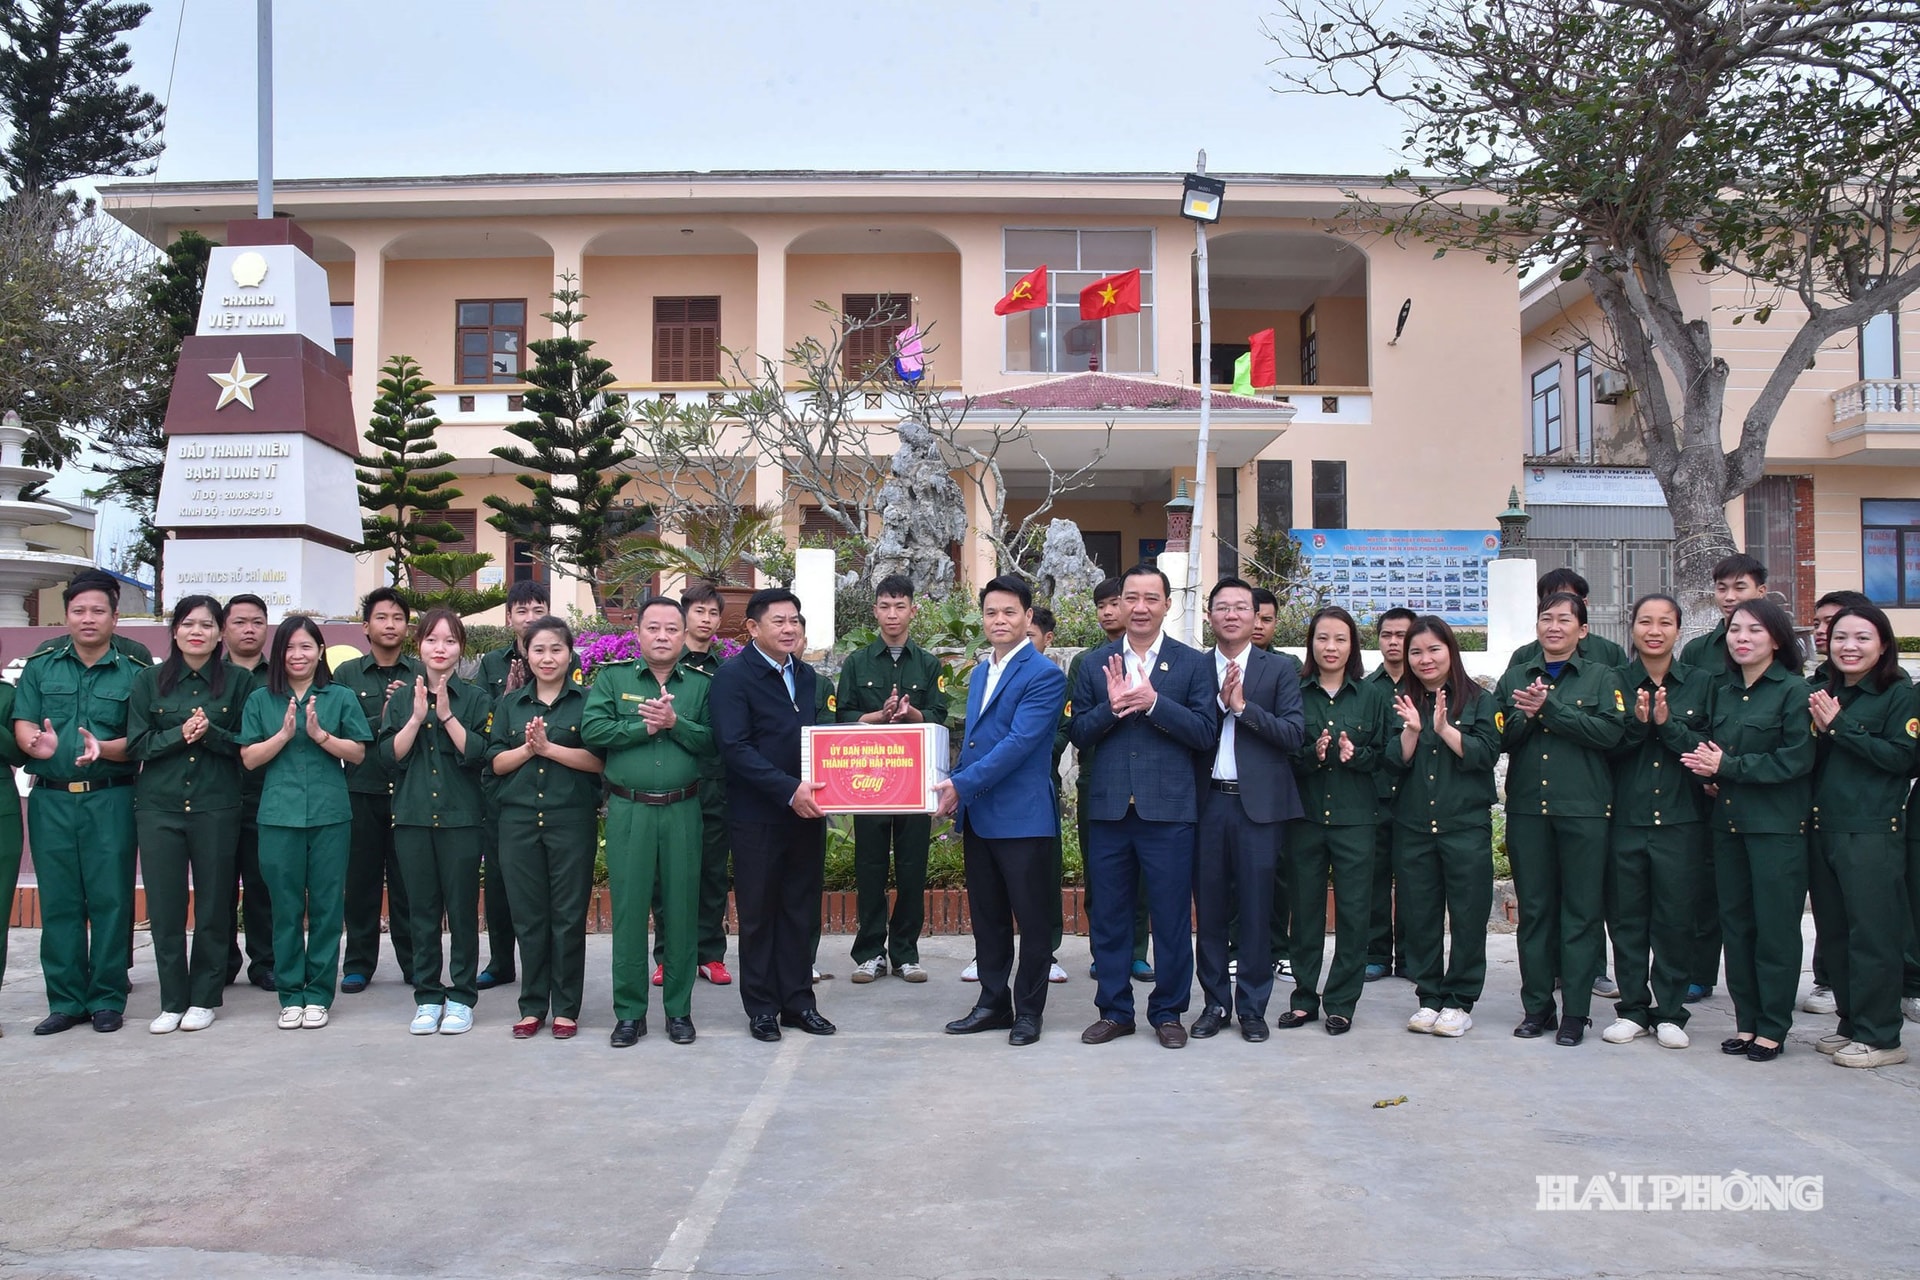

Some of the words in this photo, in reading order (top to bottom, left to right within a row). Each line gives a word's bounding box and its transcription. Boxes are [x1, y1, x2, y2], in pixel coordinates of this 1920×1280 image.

[221, 295, 275, 307] CHXHCN
[208, 311, 242, 330] VIỆT
[247, 312, 285, 327] NAM
[210, 444, 253, 459] THANH
[257, 442, 291, 458] NIÊN
[185, 465, 221, 482] BẠCH
[224, 465, 260, 480] LONG
[178, 507, 202, 517] KINH
[842, 745, 860, 755] BAN
[862, 743, 885, 755] NHÂN
[887, 743, 905, 755] DÂN
[822, 757, 849, 768] THÀNH
[850, 756, 867, 768] PHỐ
[869, 755, 883, 767] HẢI
[885, 757, 914, 767] PHÒNG
[852, 774, 884, 793] Tặng
